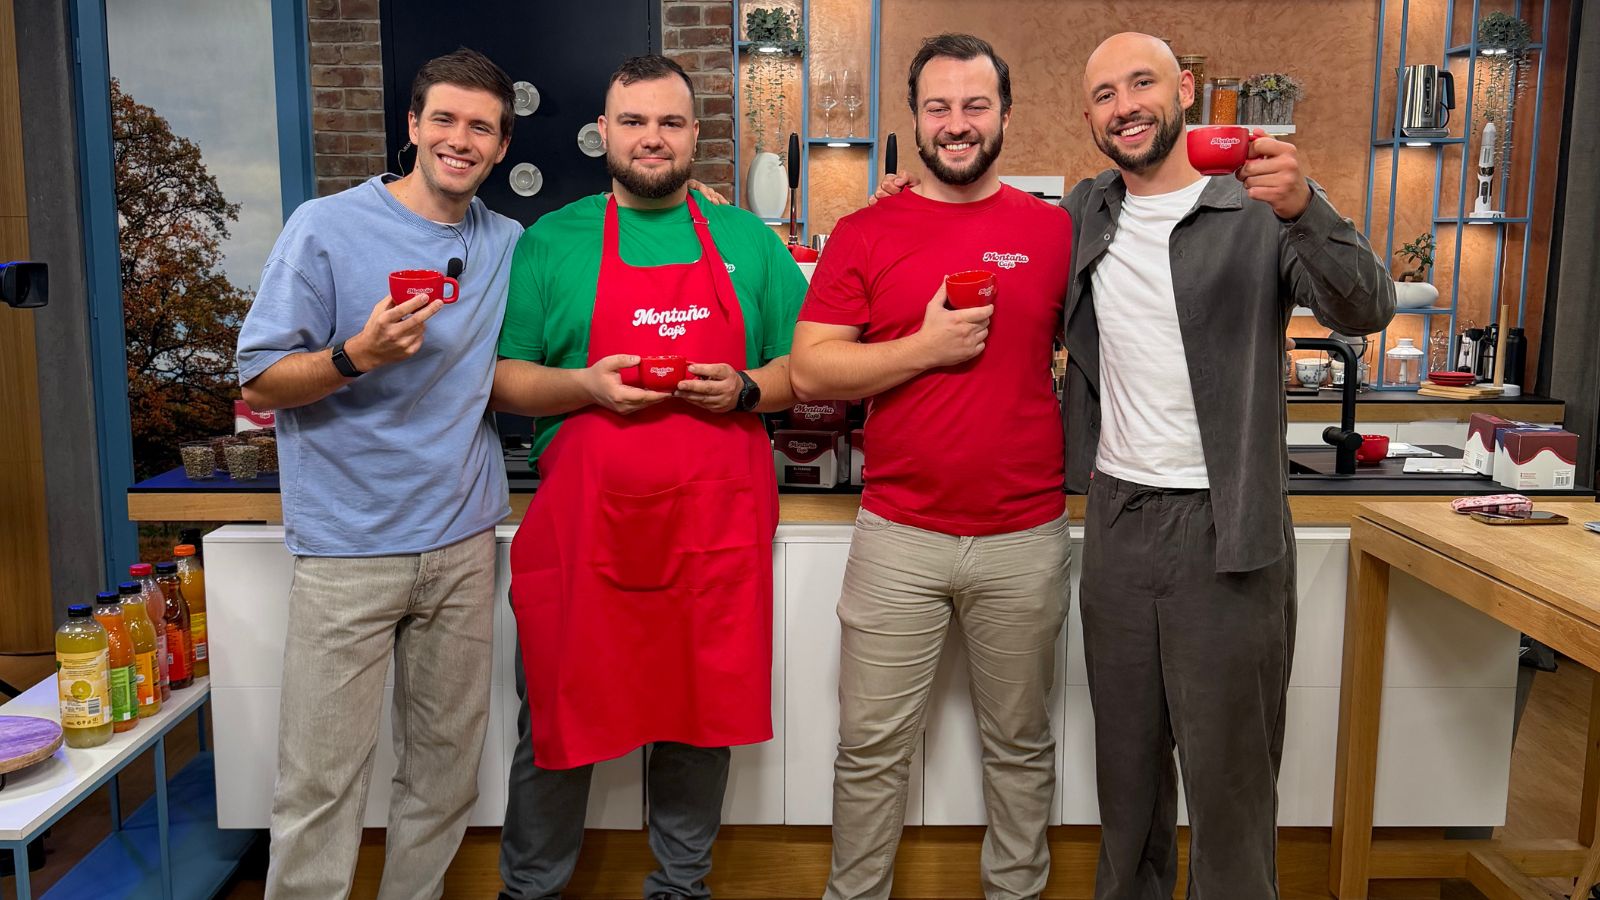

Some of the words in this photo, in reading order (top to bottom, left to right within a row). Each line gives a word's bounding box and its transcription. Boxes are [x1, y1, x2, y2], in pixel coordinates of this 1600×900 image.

[983, 252, 1029, 263] Montaña
[998, 260, 1015, 269] Café
[632, 304, 710, 326] Montaña
[658, 323, 686, 340] Café
[794, 404, 834, 414] Montaña
